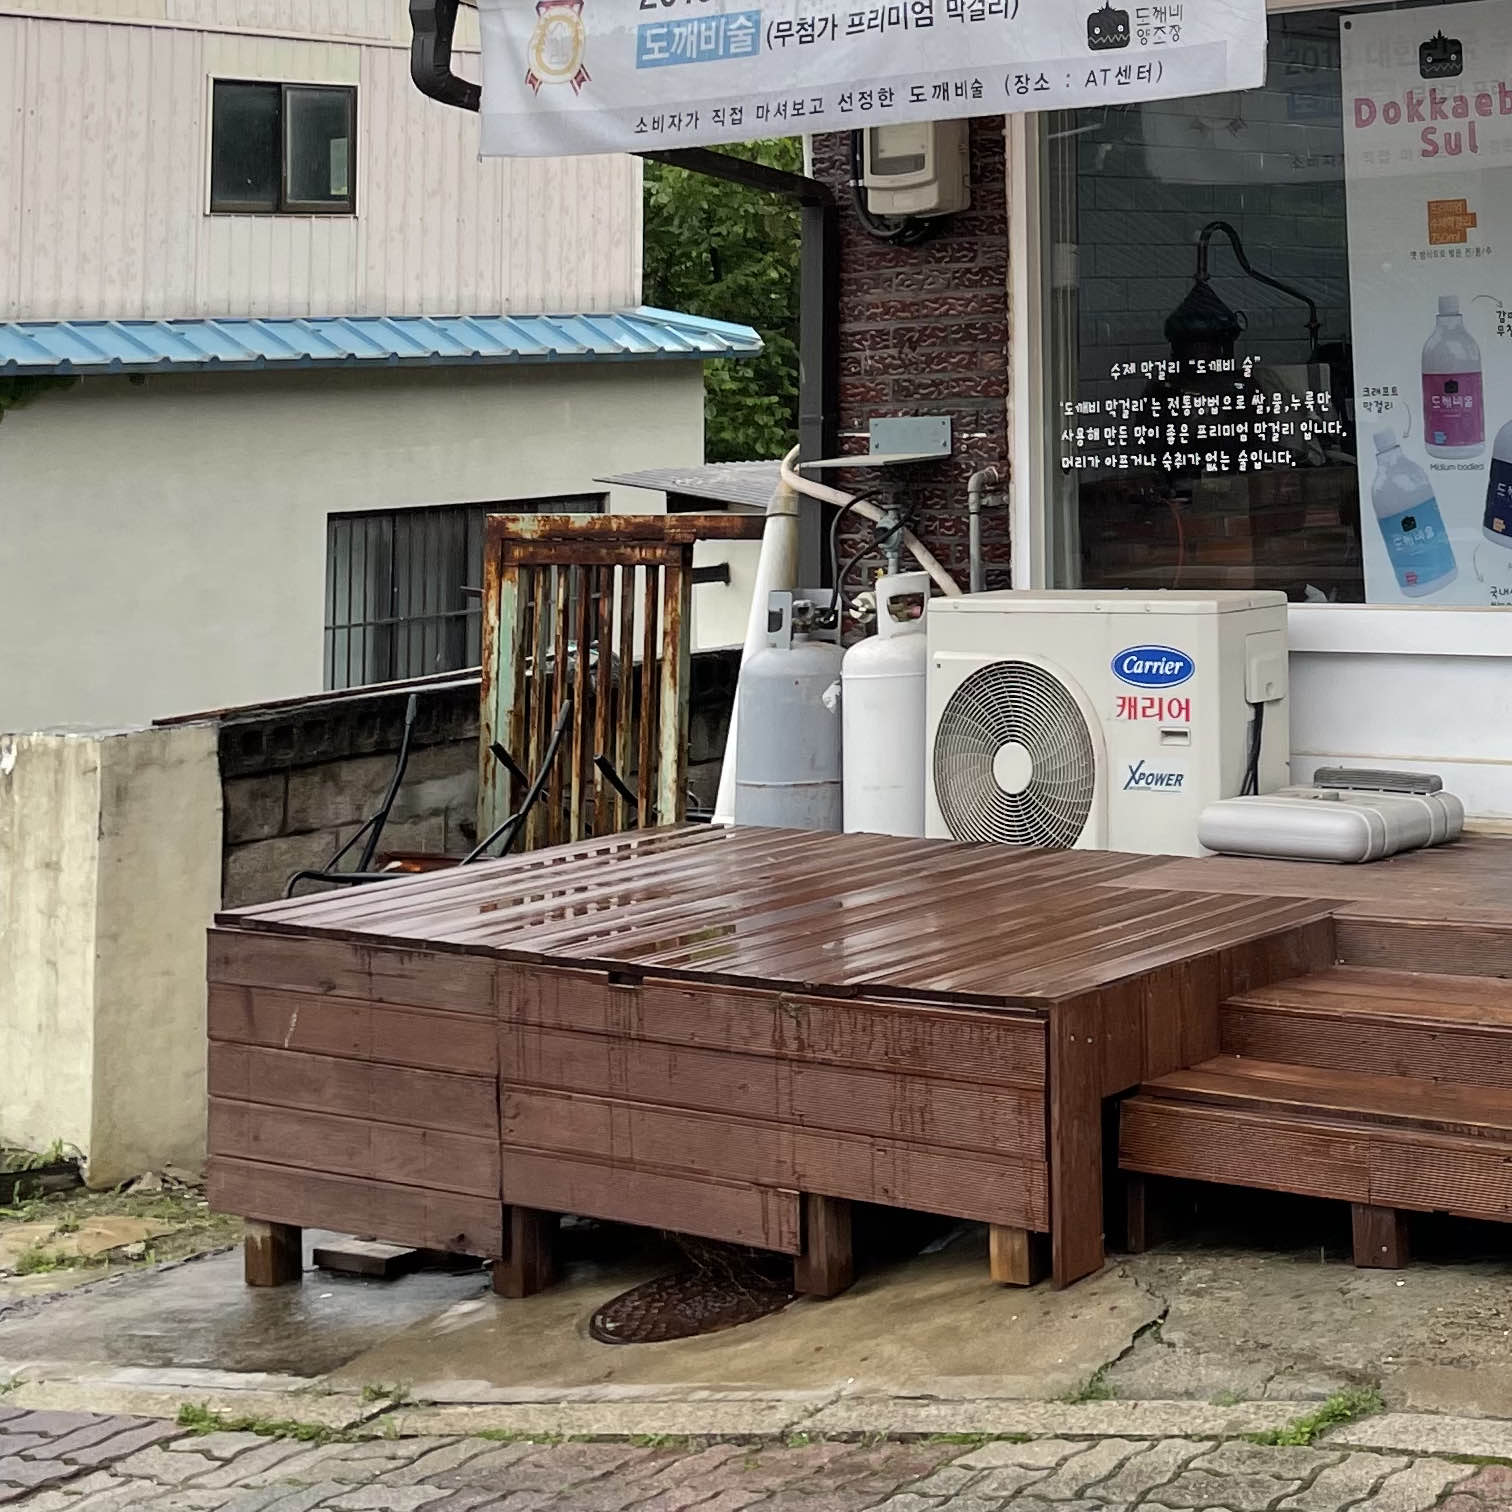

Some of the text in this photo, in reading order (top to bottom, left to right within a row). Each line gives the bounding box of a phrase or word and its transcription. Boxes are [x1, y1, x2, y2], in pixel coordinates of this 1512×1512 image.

[641, 17, 757, 61] 도깨비술
[766, 13, 839, 51] (무첨가
[633, 104, 700, 135] 소비자가
[711, 103, 745, 127] 직접
[756, 94, 826, 122] 마셔보고
[837, 86, 895, 114] 선정한
[908, 78, 985, 104] 도깨비술
[1084, 60, 1163, 90] AT센터)
[1420, 120, 1479, 157] Sul
[1110, 362, 1136, 381] 수제
[1140, 360, 1180, 381] 막걸리
[1167, 394, 1246, 417] 전통방법으로
[1363, 401, 1393, 414] 막걸리
[1061, 419, 1347, 447] 사용해 만든 맛이 좋은 프리미엄 막걸리 입니다.
[1061, 449, 1297, 471] 머리가 아프거나 숙취가 없는 술입니다.
[1122, 655, 1184, 675] Carrier
[1116, 695, 1191, 723] 캐리어
[1123, 760, 1185, 790] XPOWER
